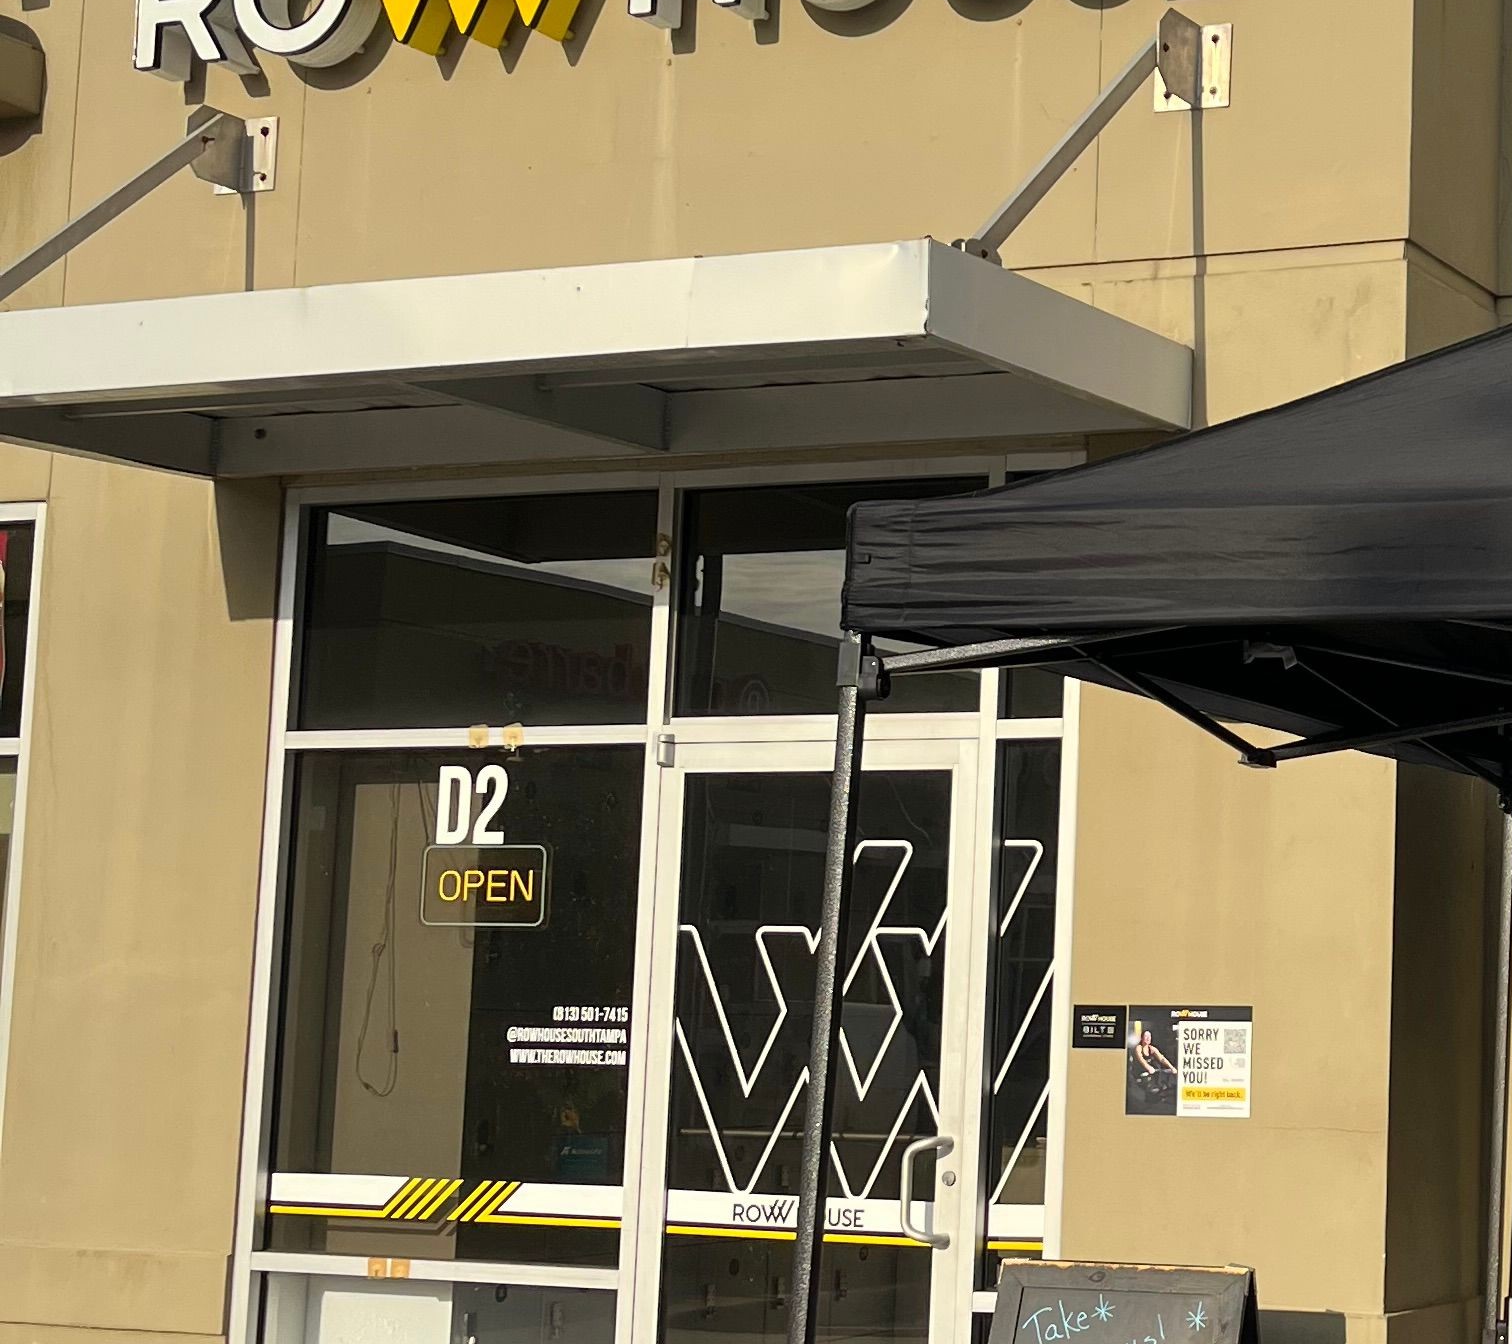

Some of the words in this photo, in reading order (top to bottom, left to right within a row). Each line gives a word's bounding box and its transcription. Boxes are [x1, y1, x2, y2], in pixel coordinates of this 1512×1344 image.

[435, 764, 509, 845] D2
[439, 869, 534, 902] OPEN
[553, 1006, 580, 1022] (813)
[580, 1007, 629, 1022] 501-7415
[506, 1026, 627, 1044] @ROWHOUSESOUTHTAMPA
[1183, 1028, 1219, 1041] SORRY
[509, 1049, 627, 1065] WWW.THEROWHOUSE.COM
[1183, 1043, 1201, 1055] WE
[1183, 1057, 1224, 1070] MISSED
[1182, 1072, 1208, 1084] YOU!
[1022, 1299, 1091, 1344] Take
